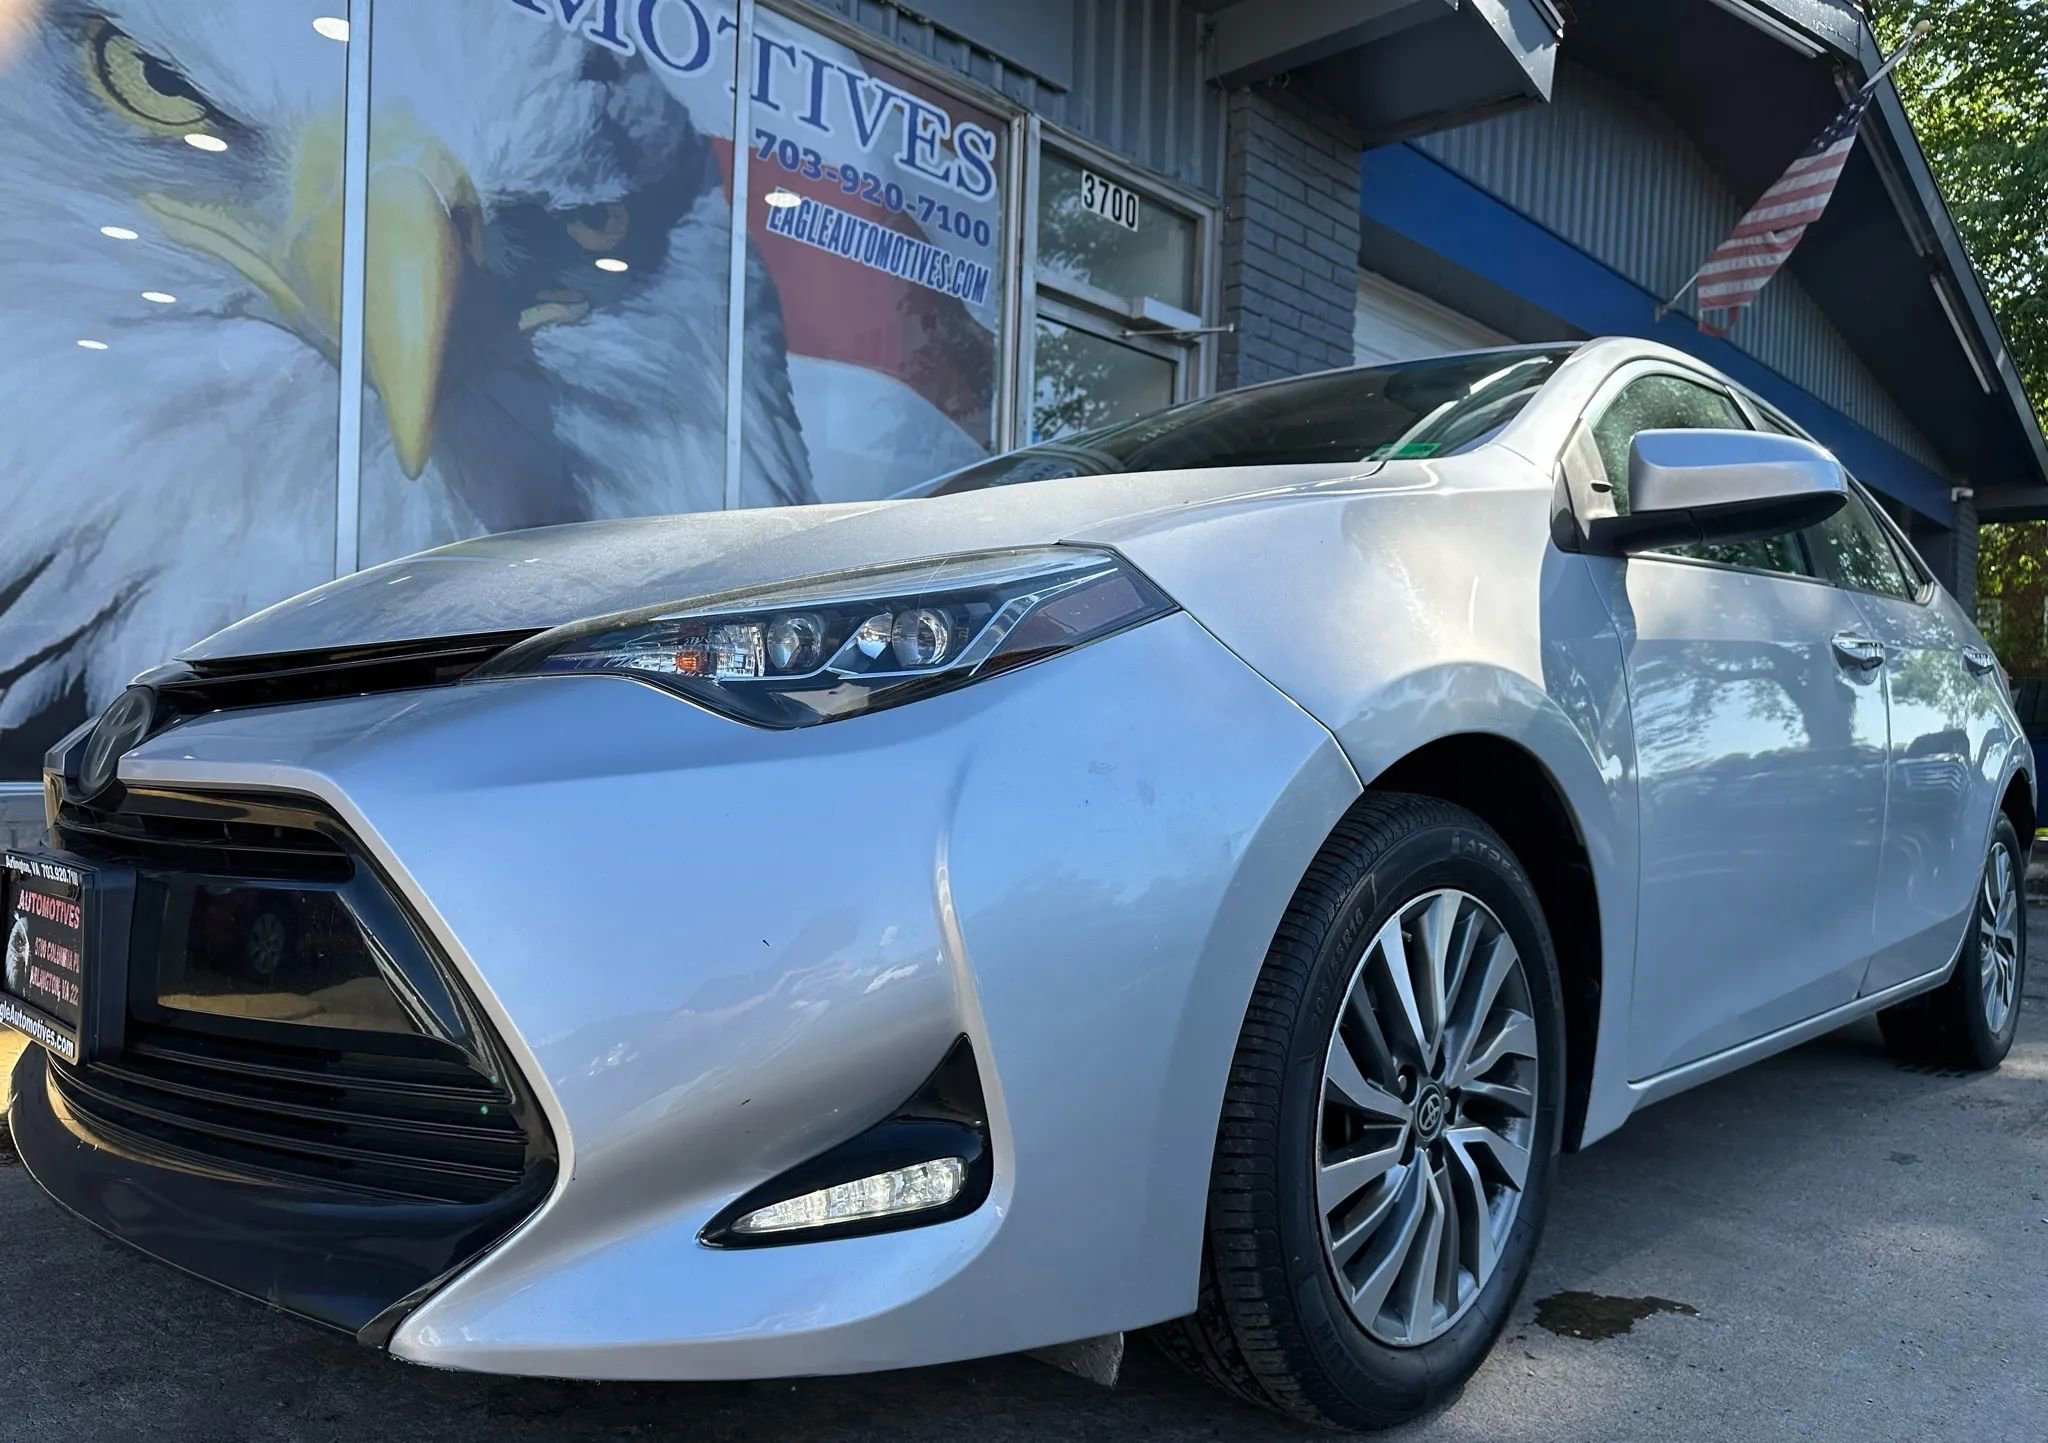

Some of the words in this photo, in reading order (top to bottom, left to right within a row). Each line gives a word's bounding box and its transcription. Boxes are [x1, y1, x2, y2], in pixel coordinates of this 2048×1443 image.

[756, 127, 991, 247] 703-920-7100
[1083, 173, 1137, 229] 3700
[768, 189, 989, 303] EAGLEAUTOMOTIVES.COM
[17, 889, 80, 929] AUTOMOTIVES
